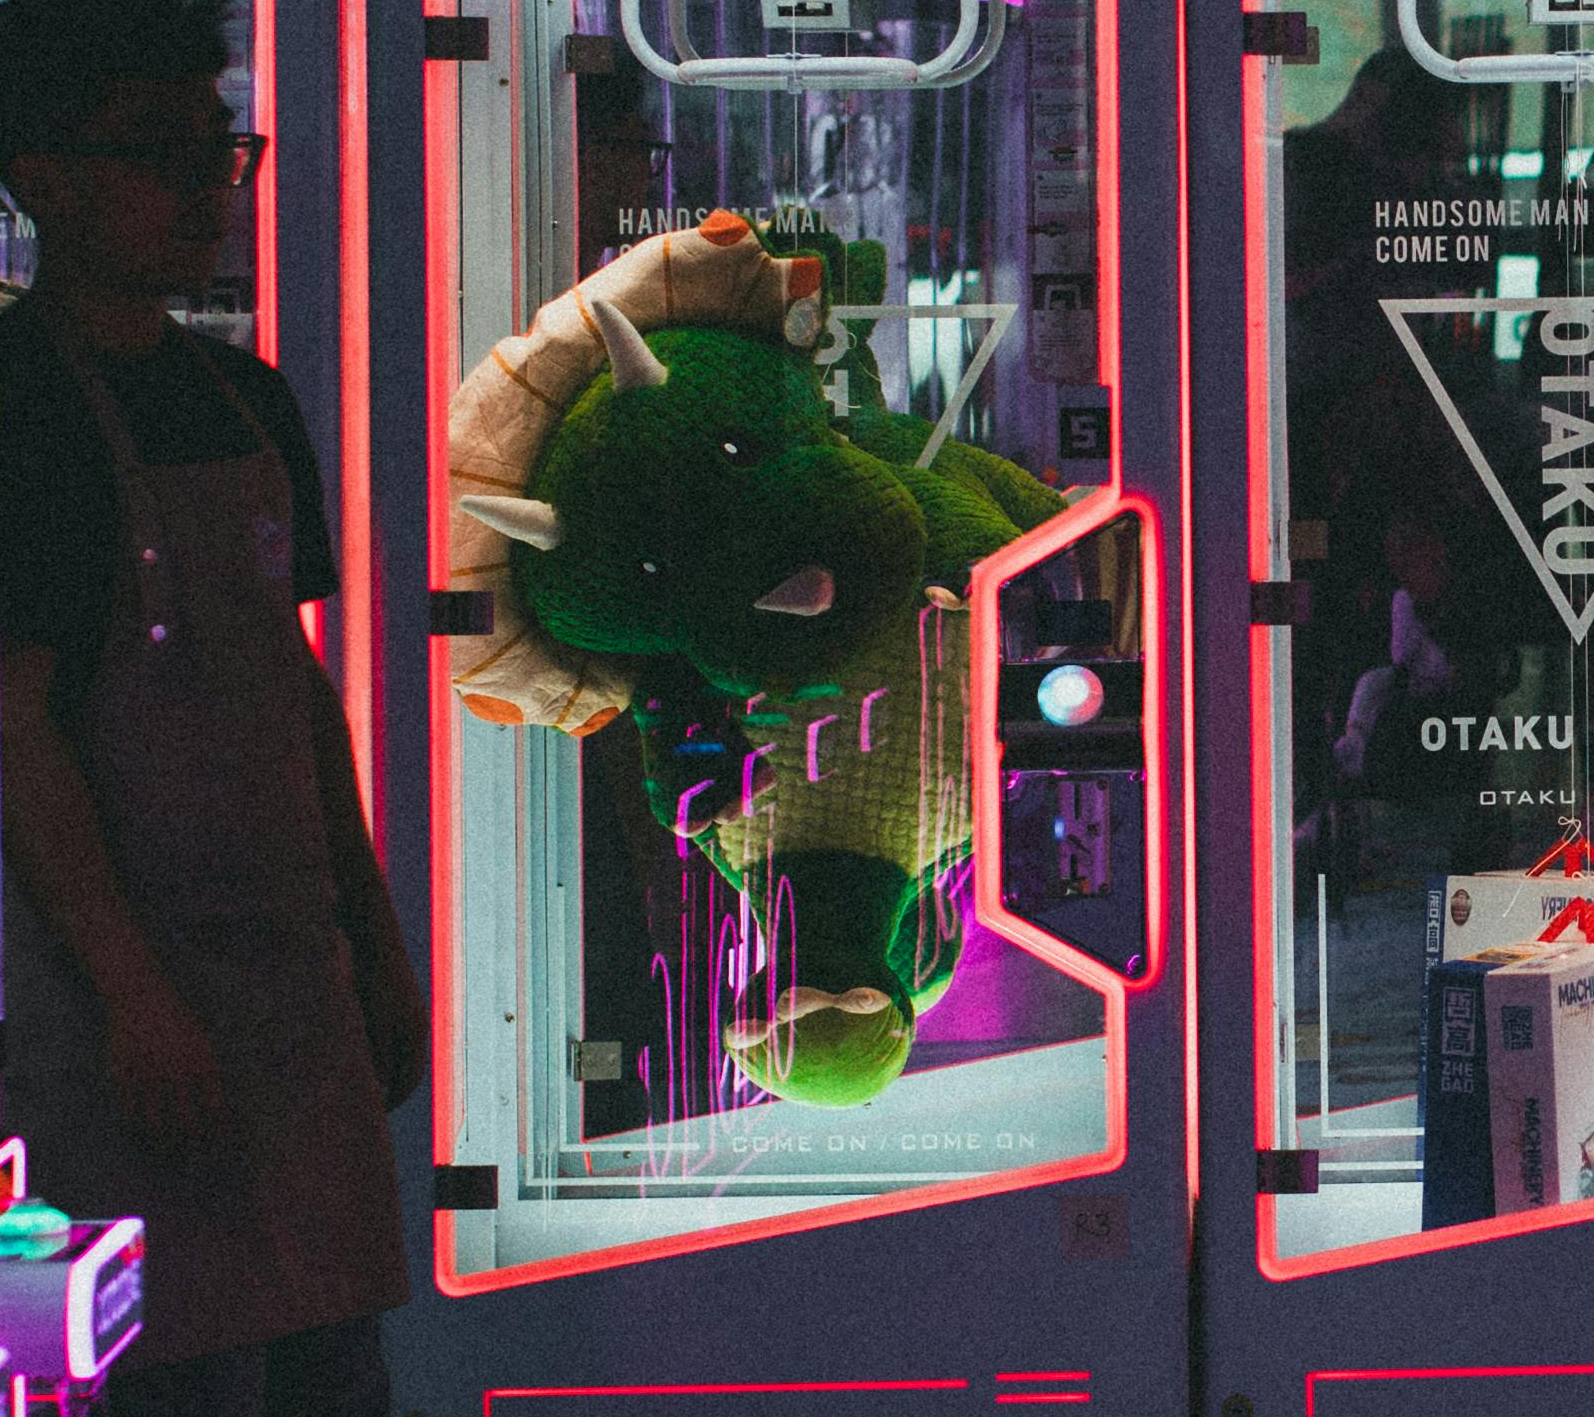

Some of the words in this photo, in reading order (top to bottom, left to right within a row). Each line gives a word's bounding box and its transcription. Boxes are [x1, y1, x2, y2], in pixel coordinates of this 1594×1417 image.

[1375, 200, 1523, 228] HANDSOME
[1530, 198, 1589, 226] MAN
[1375, 236, 1448, 263] COME
[1456, 235, 1489, 262] ON
[1420, 716, 1575, 752] OTAKU
[1479, 789, 1576, 807] OTAKU
[732, 1135, 812, 1154] COME
[827, 1134, 867, 1152] ON
[901, 1133, 981, 1150] COME
[996, 1132, 1035, 1149] ON
[1524, 1098, 1545, 1206] MACHINERY
